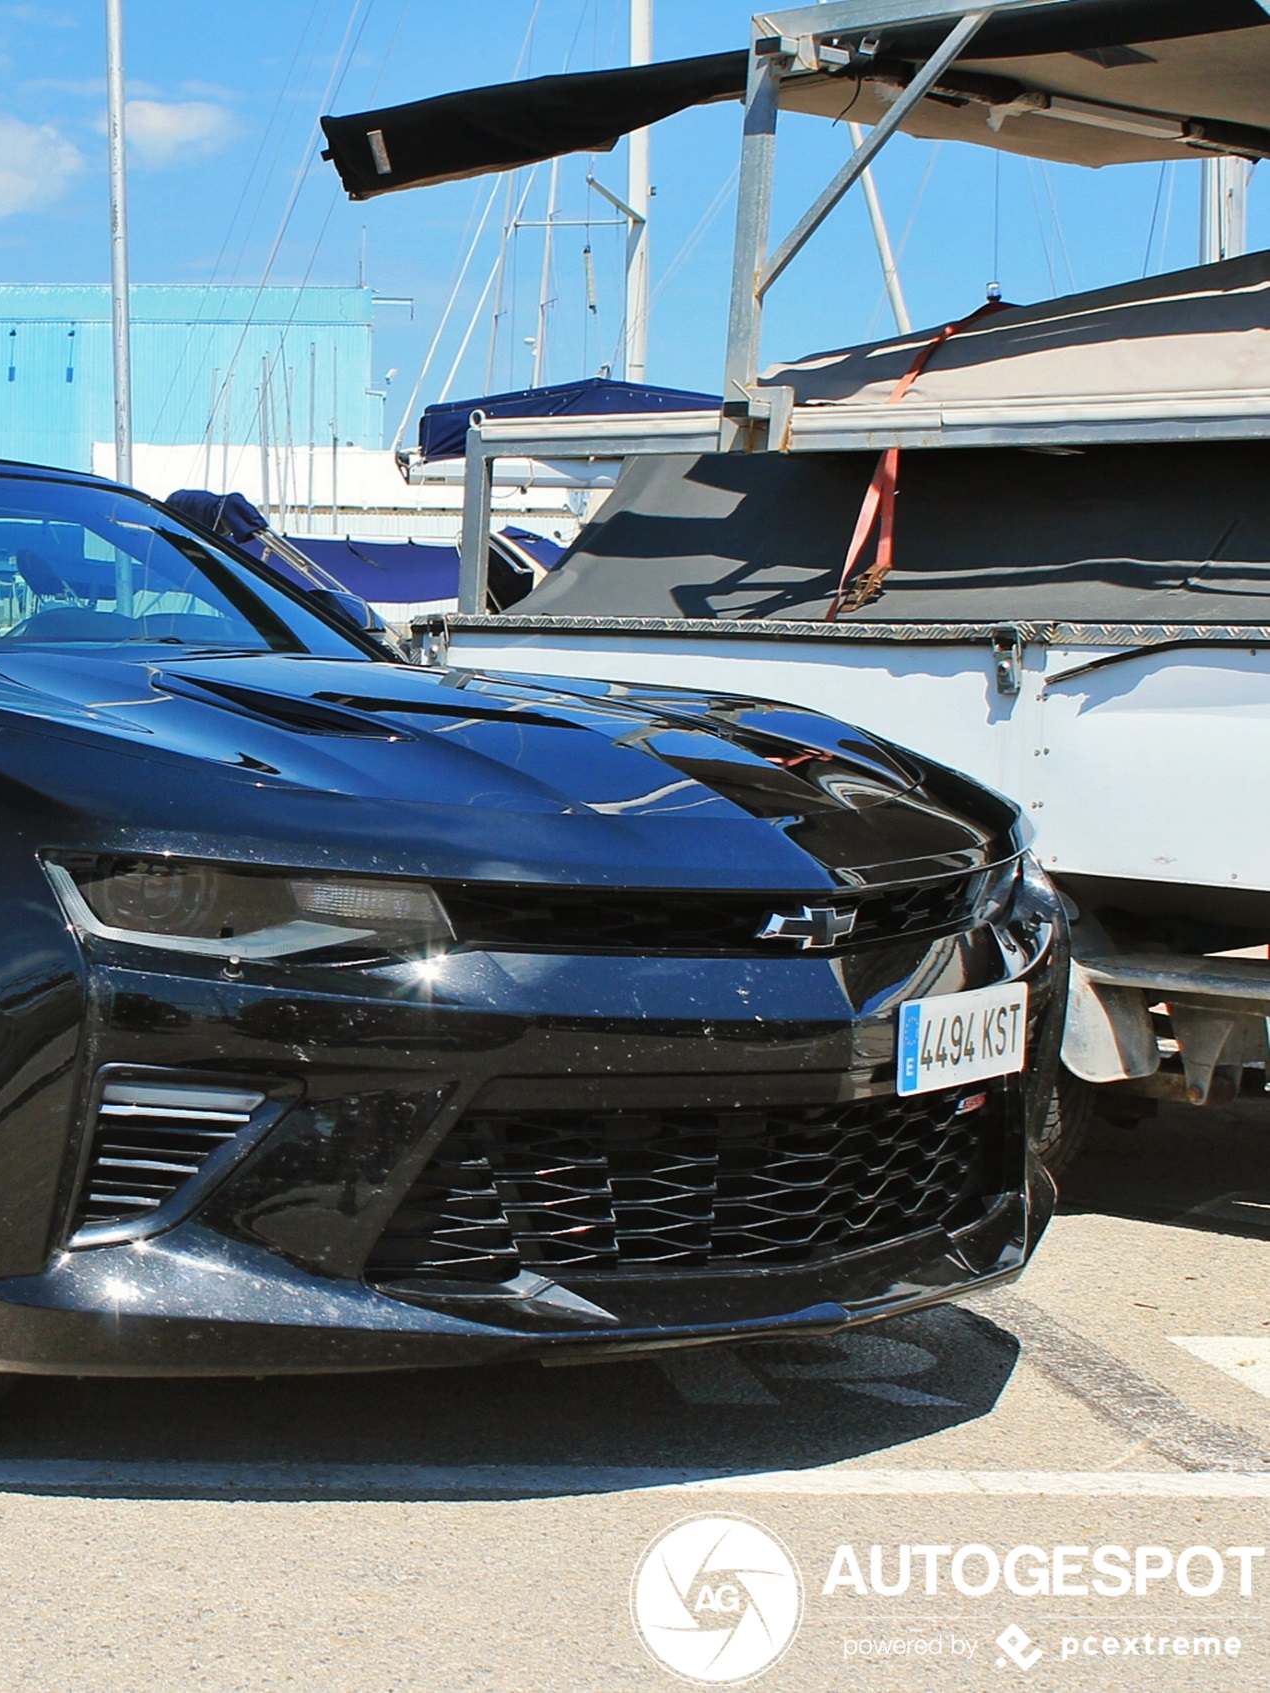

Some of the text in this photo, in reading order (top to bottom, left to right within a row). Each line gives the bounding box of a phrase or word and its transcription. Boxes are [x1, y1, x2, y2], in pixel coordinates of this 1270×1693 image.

[920, 1003, 1021, 1071] 4494 KST
[905, 1057, 914, 1077] E
